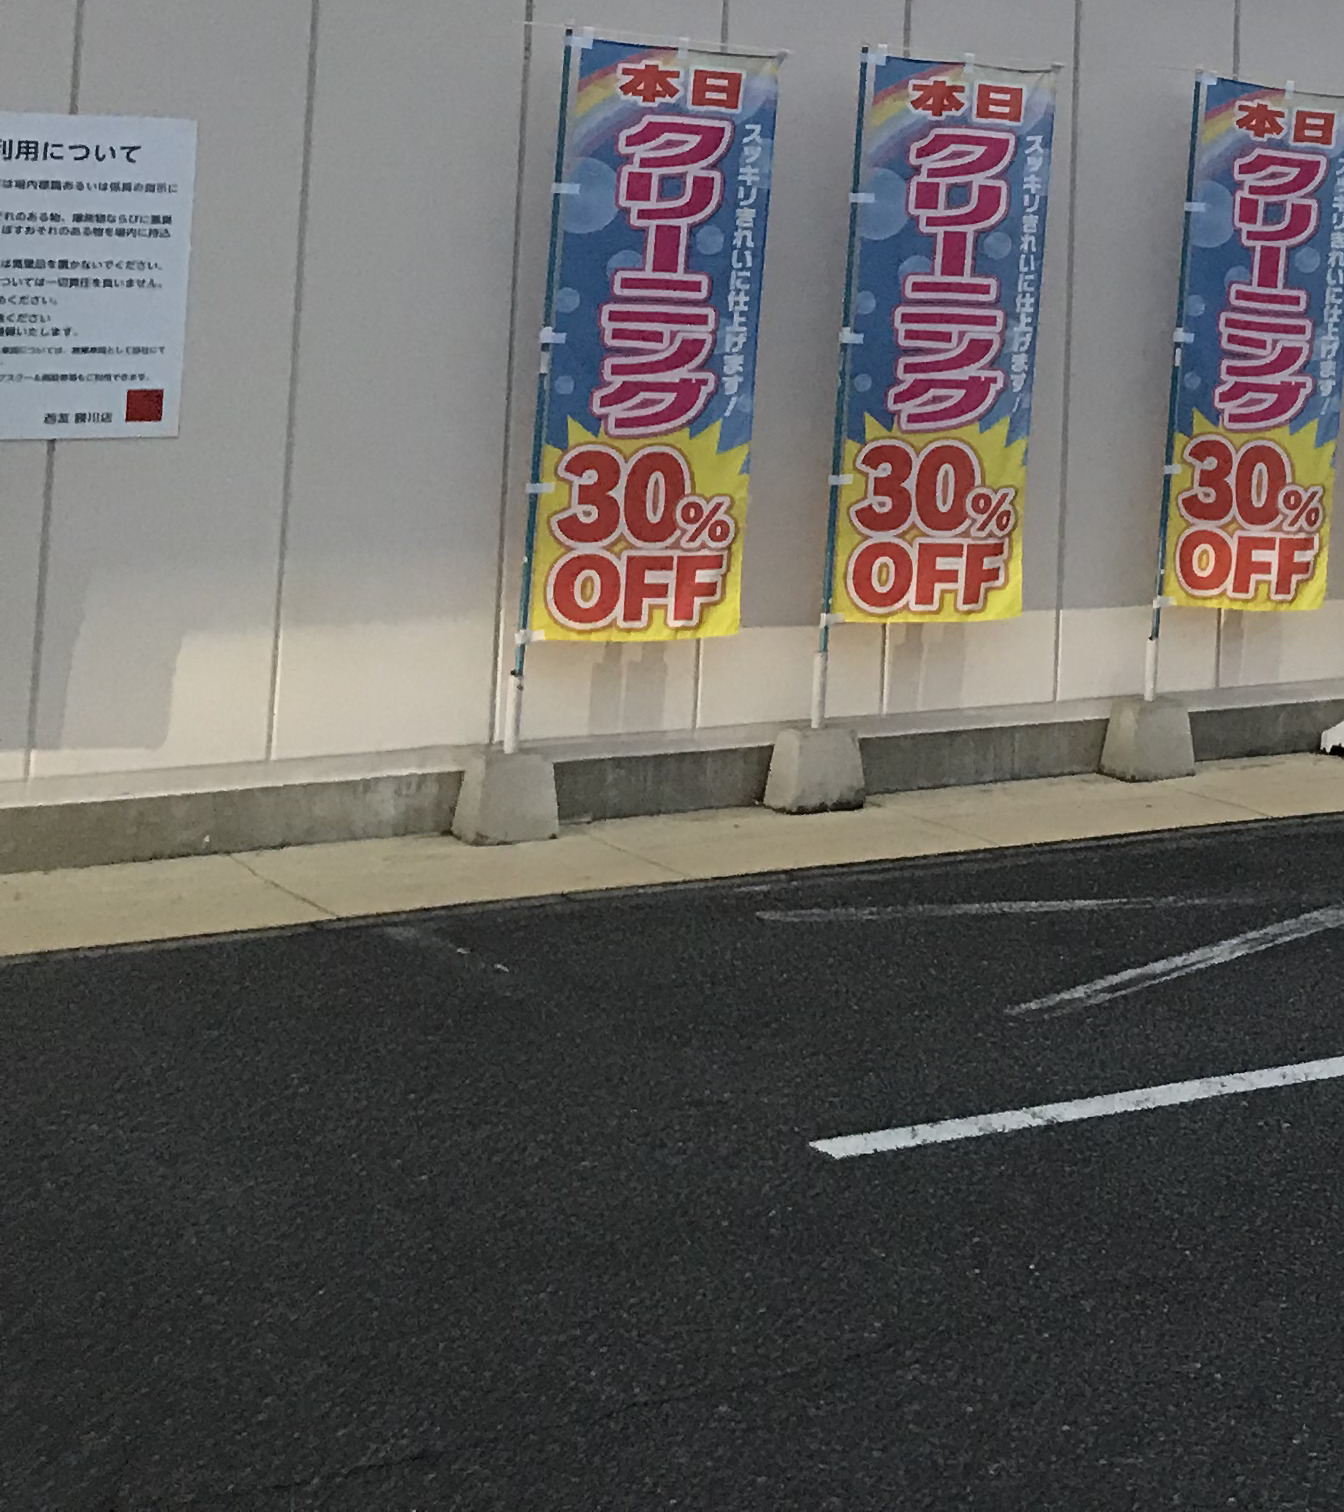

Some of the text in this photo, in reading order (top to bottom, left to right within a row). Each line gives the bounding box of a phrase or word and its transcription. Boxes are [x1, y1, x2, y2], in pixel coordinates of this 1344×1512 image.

[619, 61, 746, 114] 本日
[911, 79, 1027, 124] 本日
[1234, 100, 1338, 148] 本日
[593, 115, 733, 437] クリーニング
[886, 127, 1017, 434] クリーニング
[1213, 148, 1329, 432] クリーニング
[552, 445, 737, 549] 30%
[851, 440, 1017, 539] 30%
[1180, 435, 1325, 531] 30%
[546, 550, 728, 631] OFF
[847, 539, 1009, 614] OFF
[1176, 527, 1319, 602] OFF
